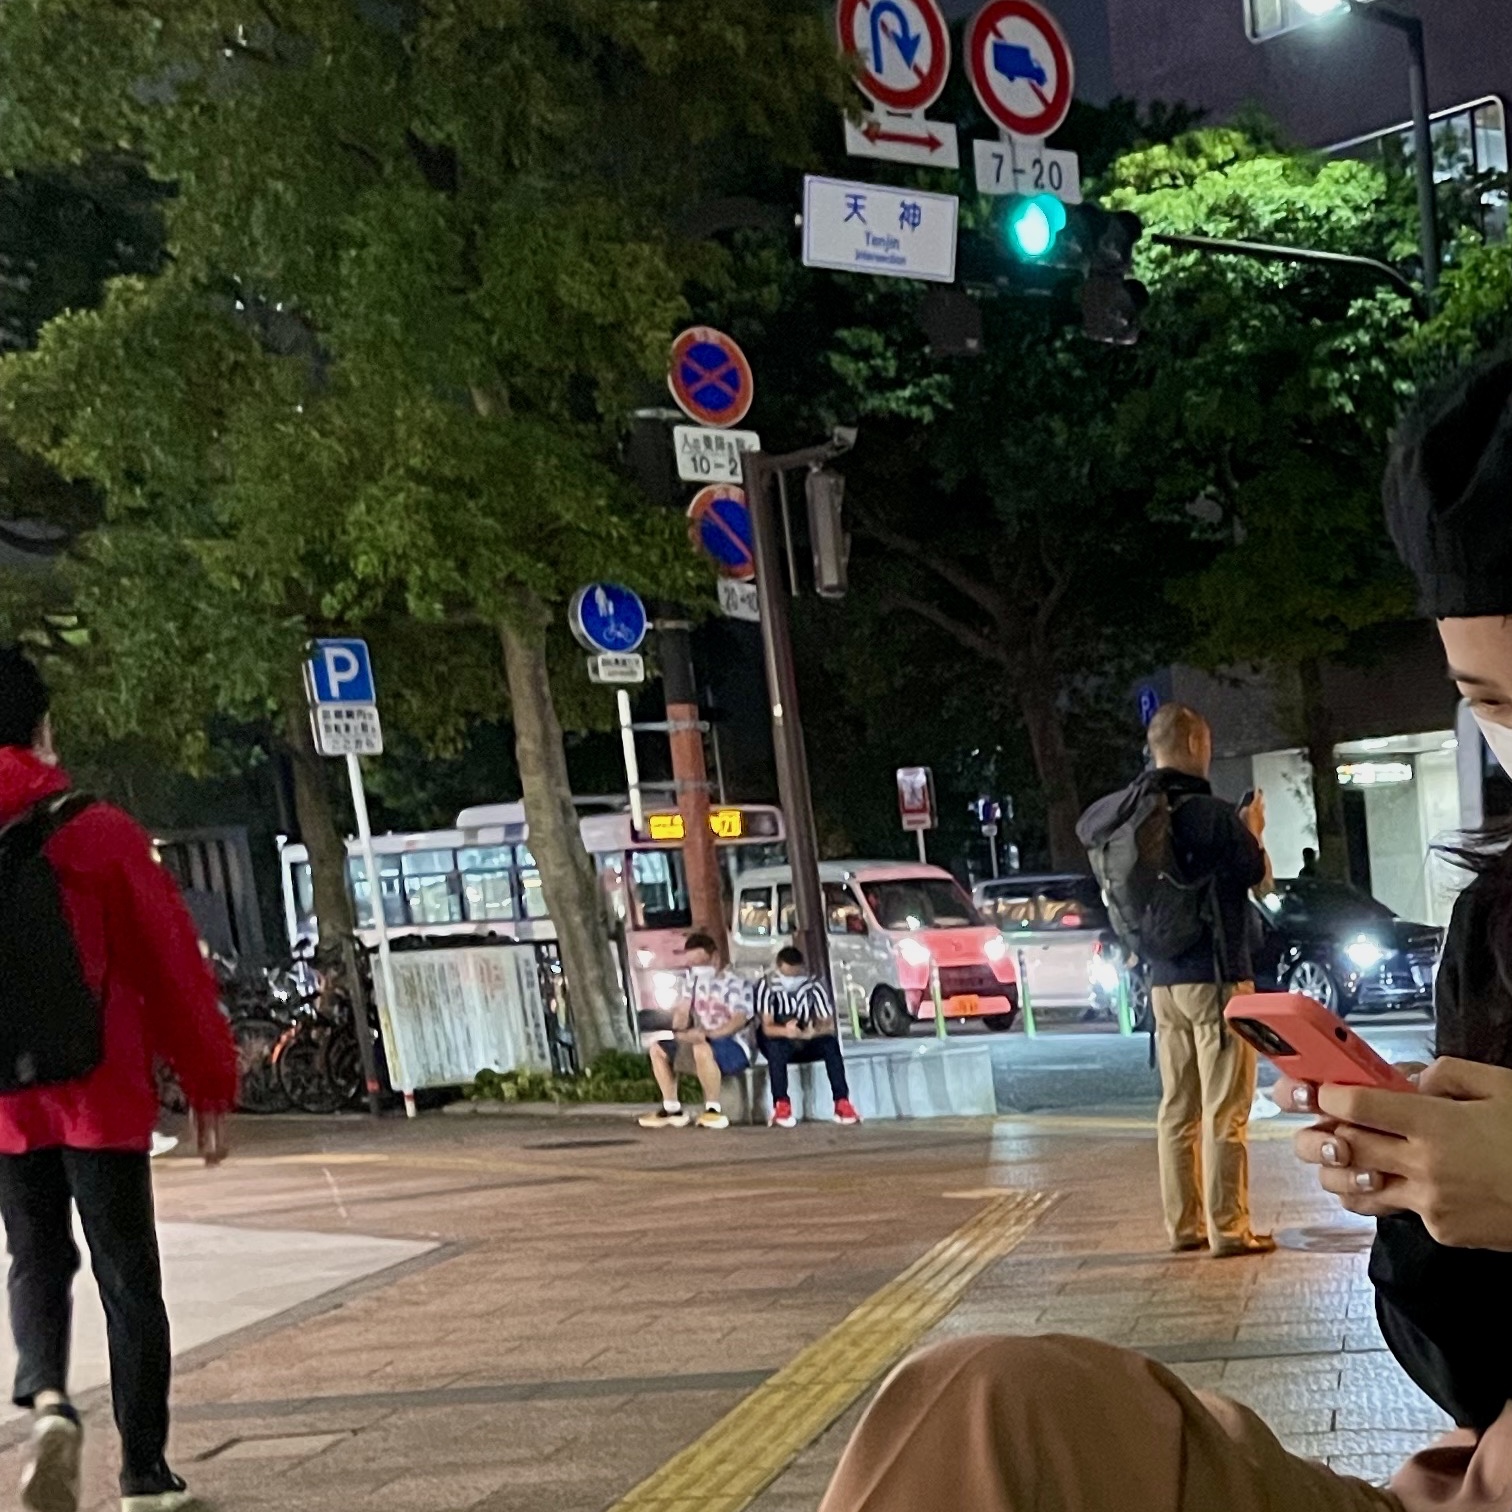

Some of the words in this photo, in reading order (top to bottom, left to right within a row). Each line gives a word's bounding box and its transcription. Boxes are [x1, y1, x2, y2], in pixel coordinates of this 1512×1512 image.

[991, 153, 1063, 191] 7-20
[843, 193, 922, 232] 天神
[324, 647, 360, 698] P
